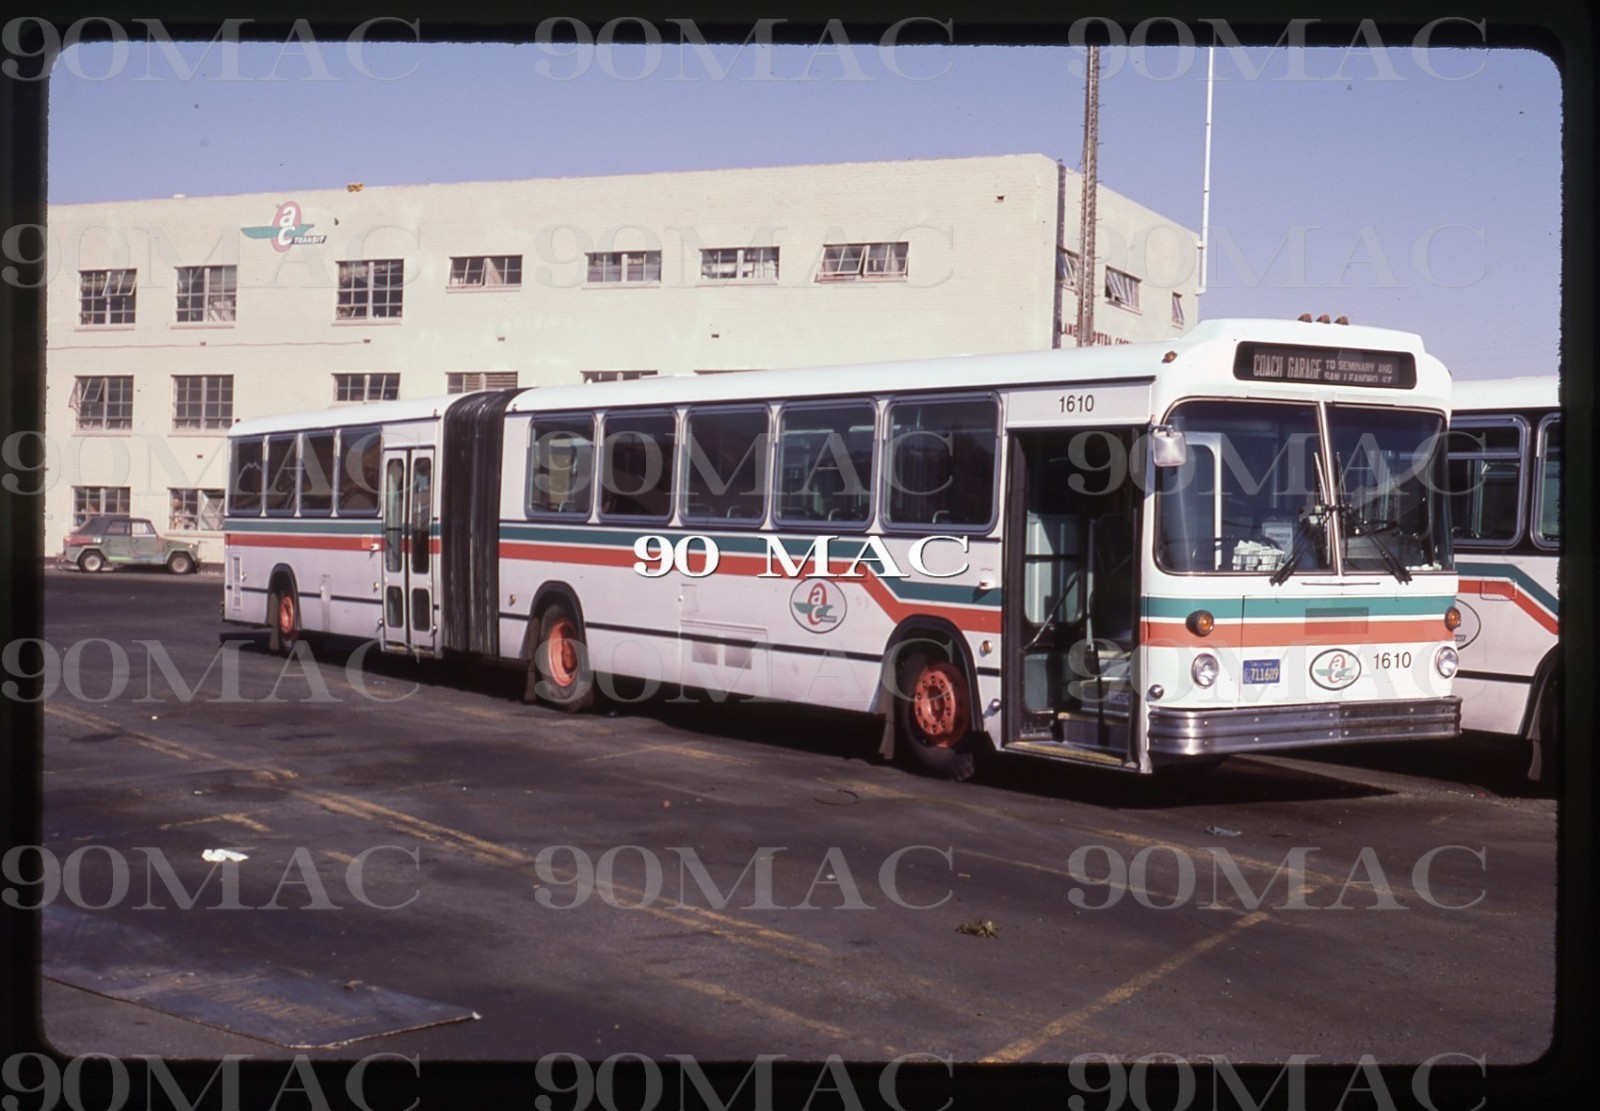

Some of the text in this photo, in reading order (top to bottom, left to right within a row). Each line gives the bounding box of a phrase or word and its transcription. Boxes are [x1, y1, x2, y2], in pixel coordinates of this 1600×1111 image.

[1253, 353, 1321, 380] COACH GARAGE
[1325, 359, 1393, 374] TO SEMINARY AND
[1058, 394, 1095, 413] 1610
[1373, 652, 1412, 670] 1610
